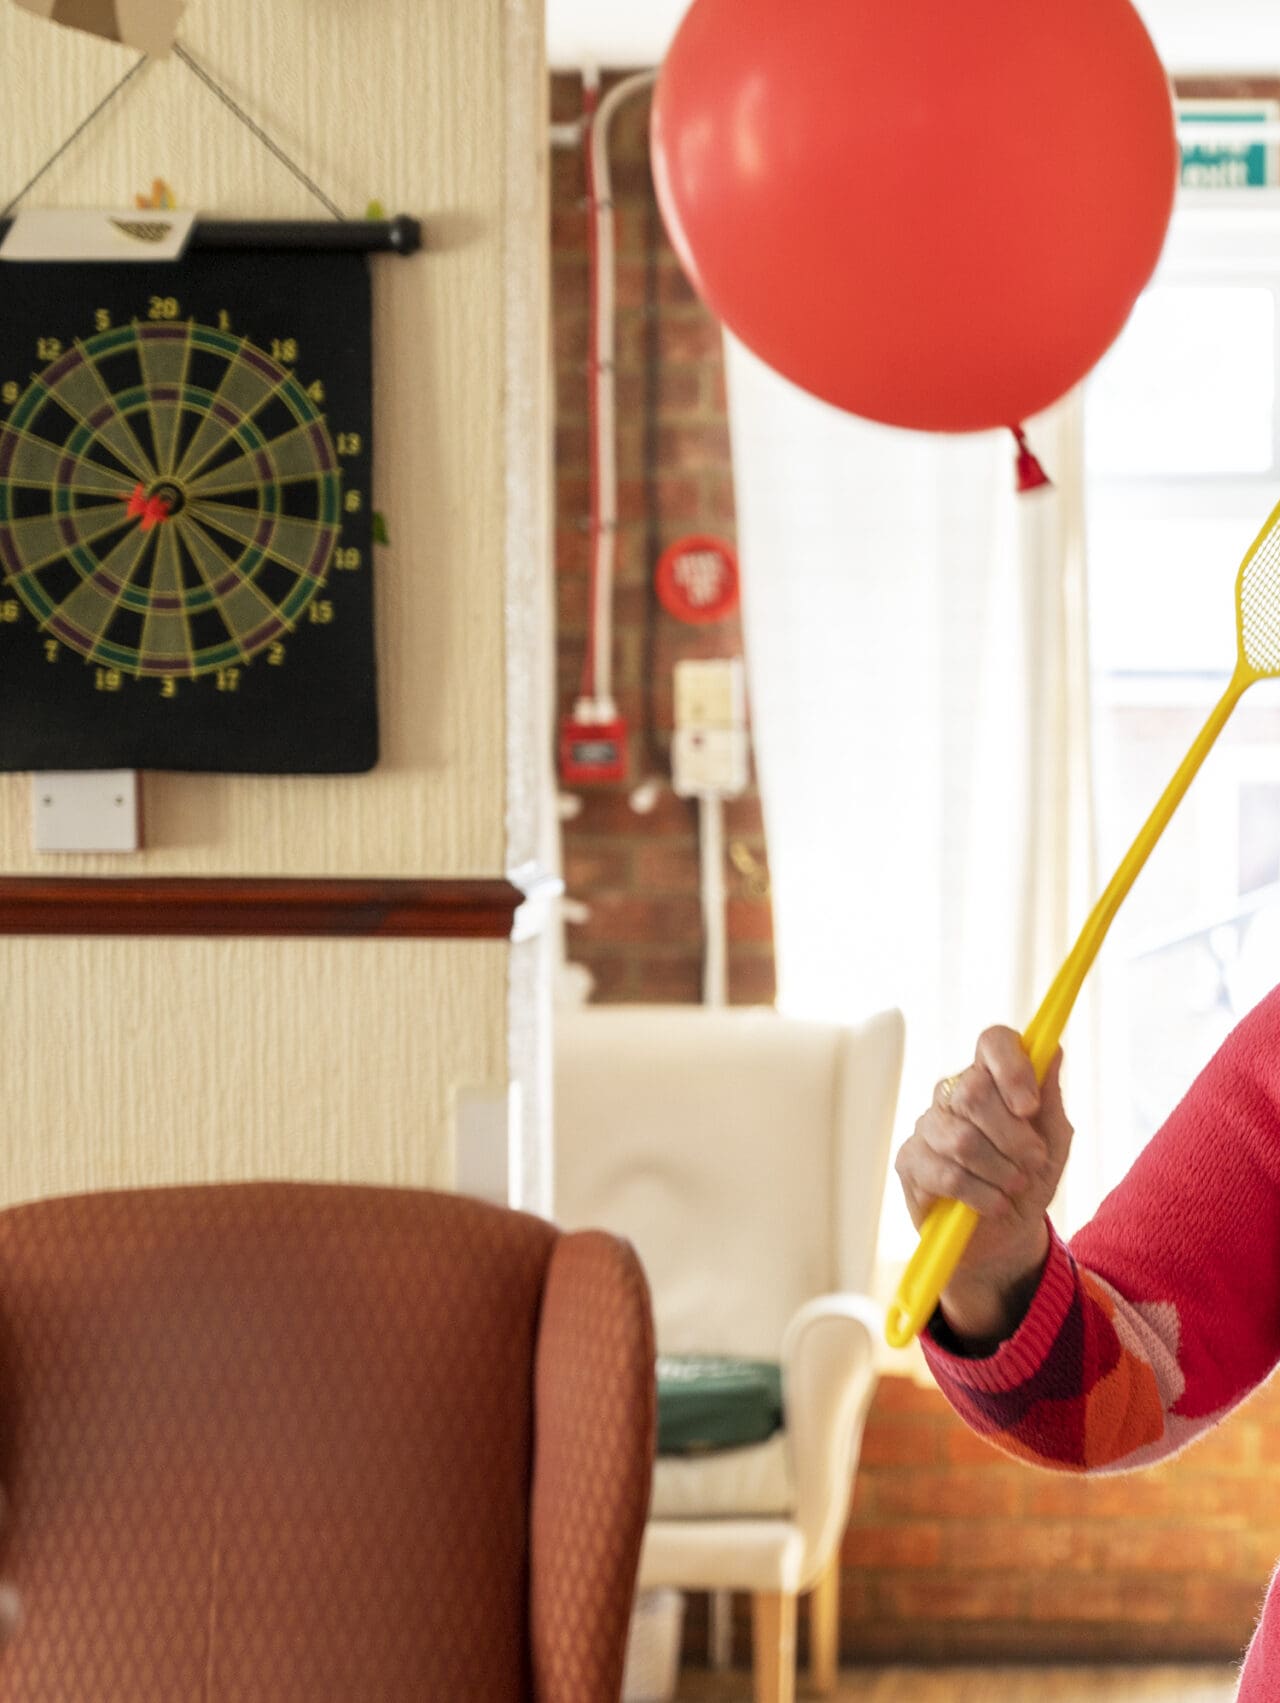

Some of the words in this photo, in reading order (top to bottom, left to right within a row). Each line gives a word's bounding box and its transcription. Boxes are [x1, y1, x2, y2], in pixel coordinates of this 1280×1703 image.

[149, 296, 179, 319] 20
[95, 308, 110, 331] 5
[218, 309, 230, 331] 1
[37, 338, 62, 361] 12
[272, 338, 297, 362] 18
[307, 379, 325, 402] 4
[337, 432, 361, 455] 13
[345, 490, 361, 513] 6
[310, 601, 334, 624] 15
[44, 639, 58, 663] 7
[268, 641, 285, 666] 2
[95, 667, 121, 691] 19
[160, 676, 176, 699] 3
[216, 667, 241, 692] 17
